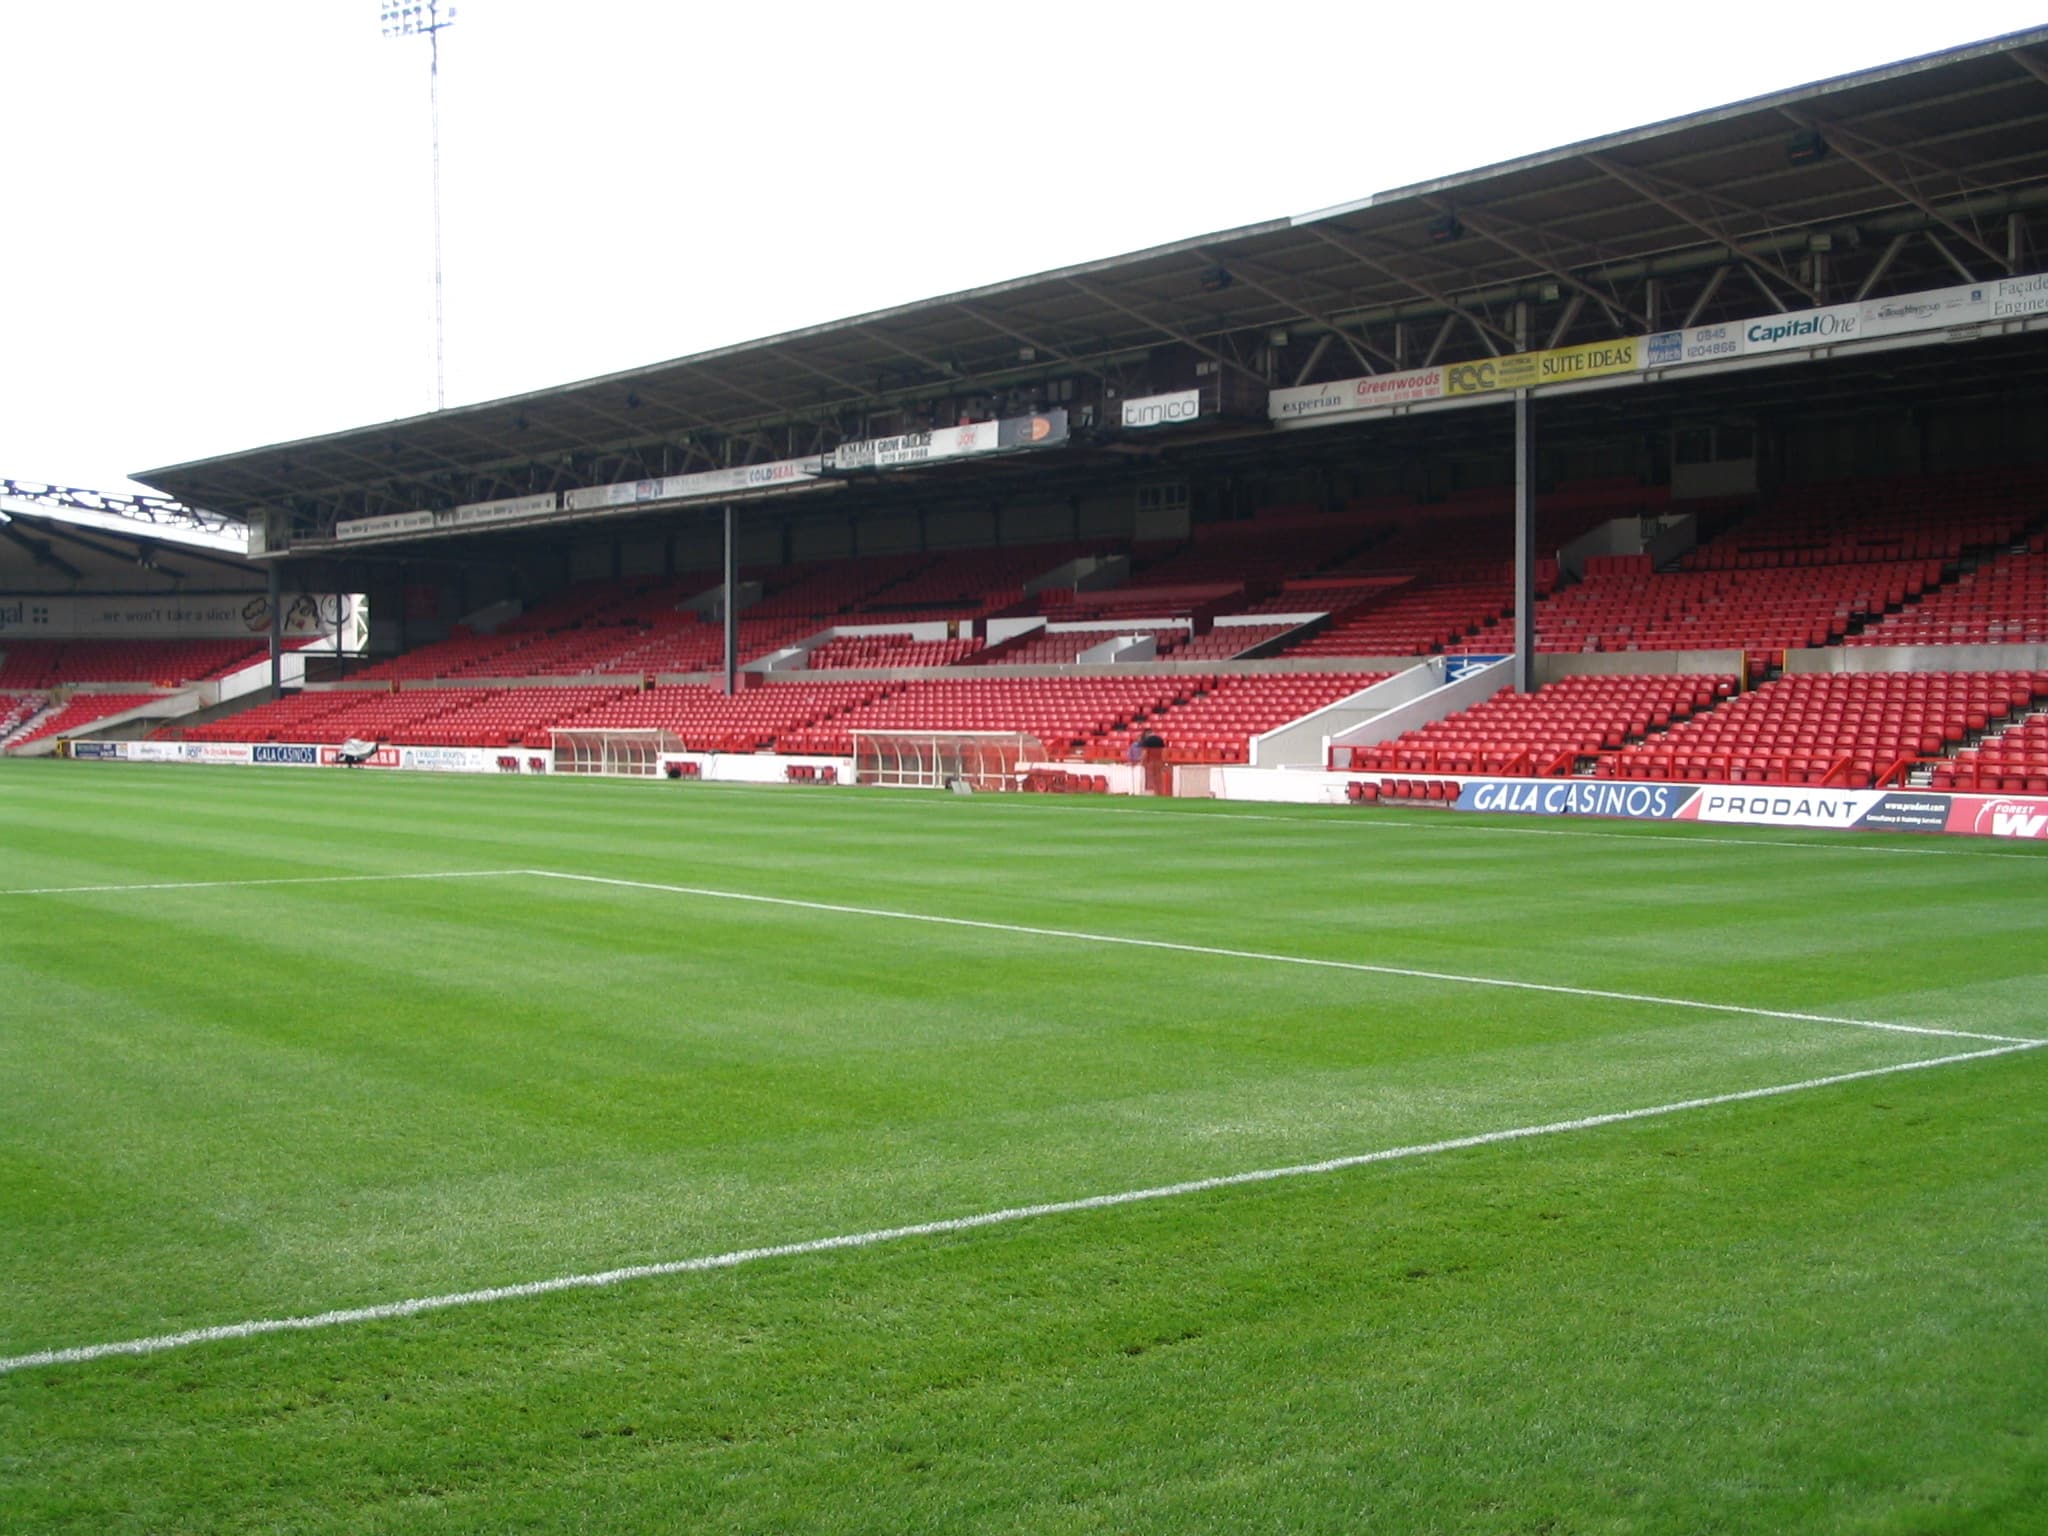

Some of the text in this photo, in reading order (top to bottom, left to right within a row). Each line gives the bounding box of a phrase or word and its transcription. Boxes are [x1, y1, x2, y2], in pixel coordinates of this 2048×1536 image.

[1994, 297, 2048, 316] Engine
[1696, 327, 1727, 342] 0845
[1542, 346, 1632, 376] SUITE IDEAS
[1356, 370, 1440, 396] Greenwoods
[1124, 400, 1196, 424] timico
[1282, 391, 1342, 414] experian
[256, 746, 276, 761] GALA
[277, 747, 313, 762] CASINOS
[1474, 783, 1668, 816] GALA CASINOS
[1708, 796, 1857, 818] PRODANT
[1884, 802, 1945, 812] www.prodant.com
[1994, 804, 2035, 814] FOREST
[1992, 813, 2048, 838] W
